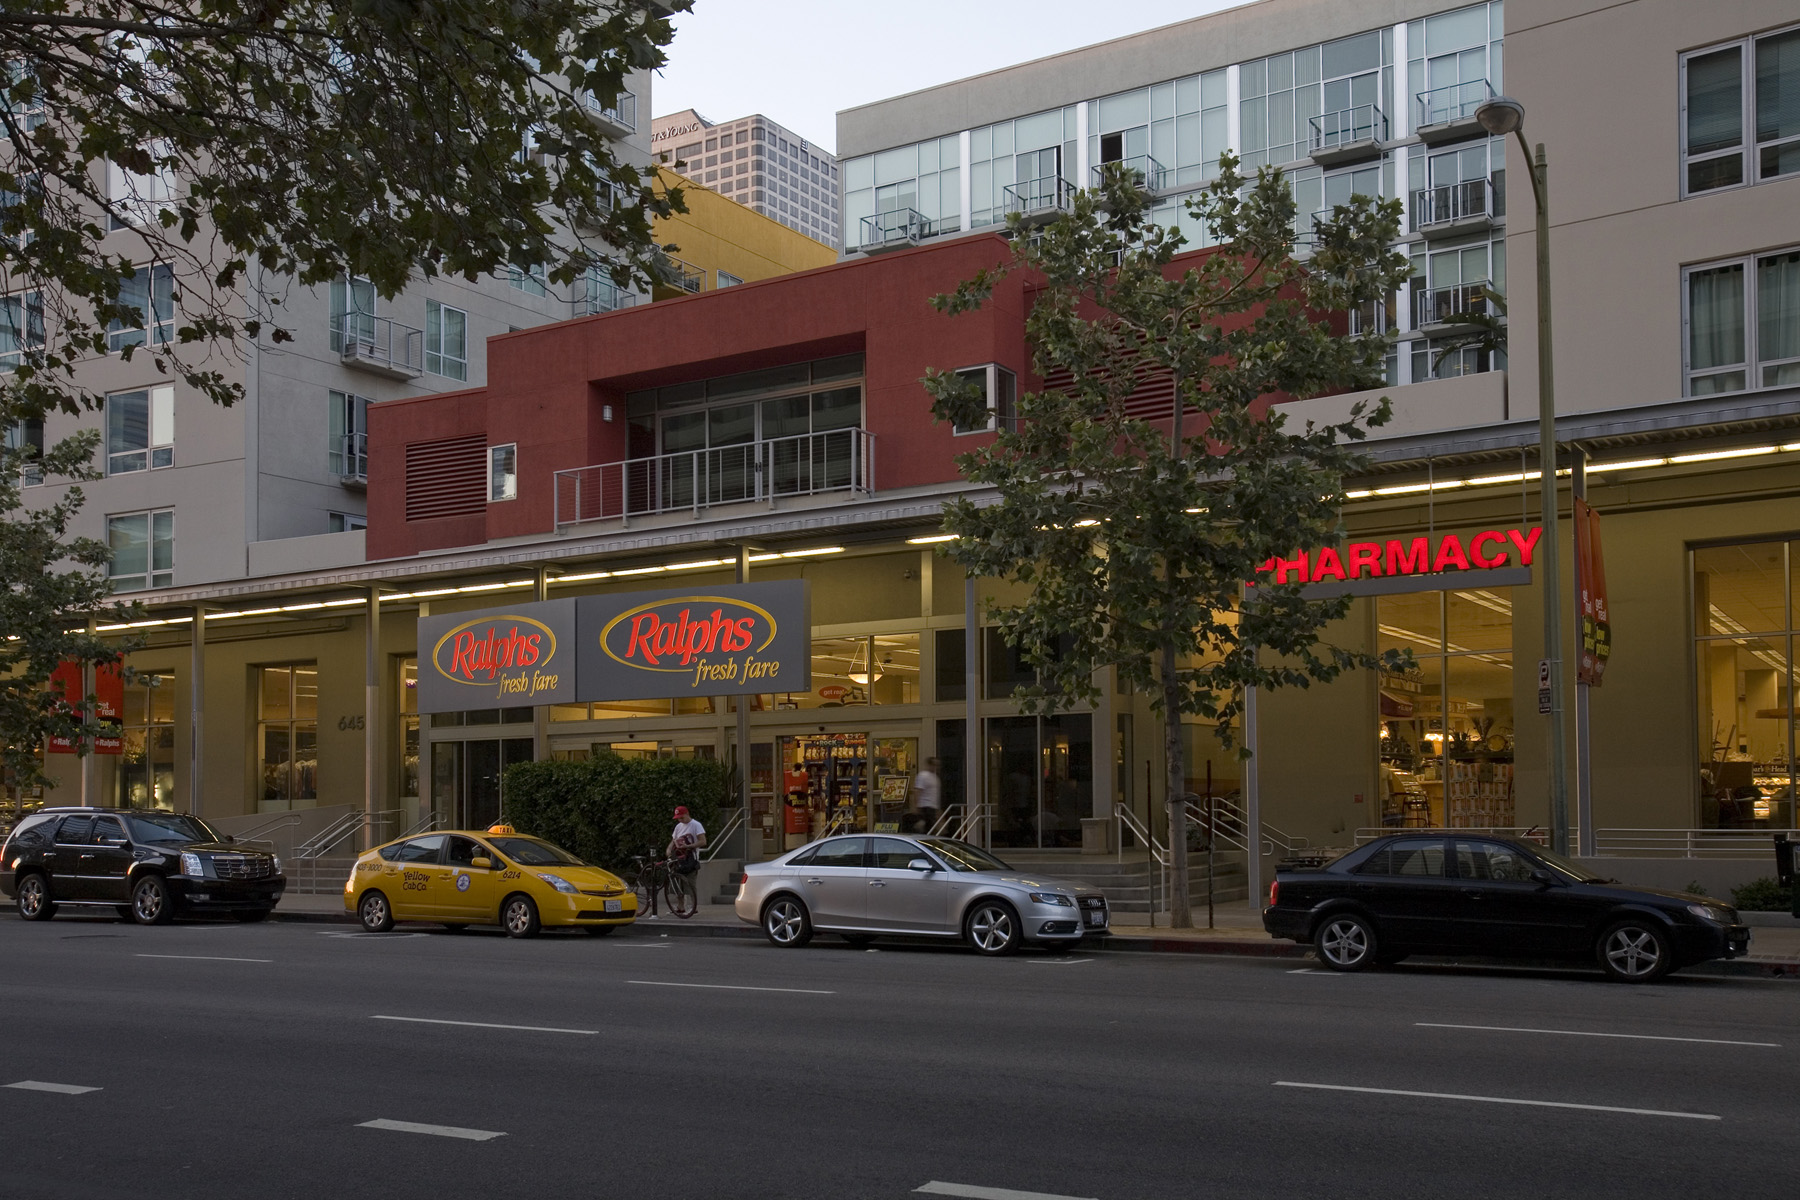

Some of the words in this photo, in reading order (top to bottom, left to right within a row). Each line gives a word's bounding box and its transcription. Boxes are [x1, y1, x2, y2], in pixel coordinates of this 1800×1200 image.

[666, 122, 699, 139] YOUNG
[625, 608, 755, 666] Ralphs
[450, 626, 541, 680] Ralphs
[692, 657, 737, 688] fresh
[738, 656, 779, 688] fare
[497, 671, 528, 699] fresh
[529, 670, 558, 697] fare
[102, 708, 115, 716] real
[338, 716, 365, 731] 645
[100, 738, 120, 748] Ralphs
[1771, 765, 1787, 773] Head
[403, 871, 431, 882] Yellow
[502, 870, 521, 879] 6214
[402, 881, 417, 891] Cab
